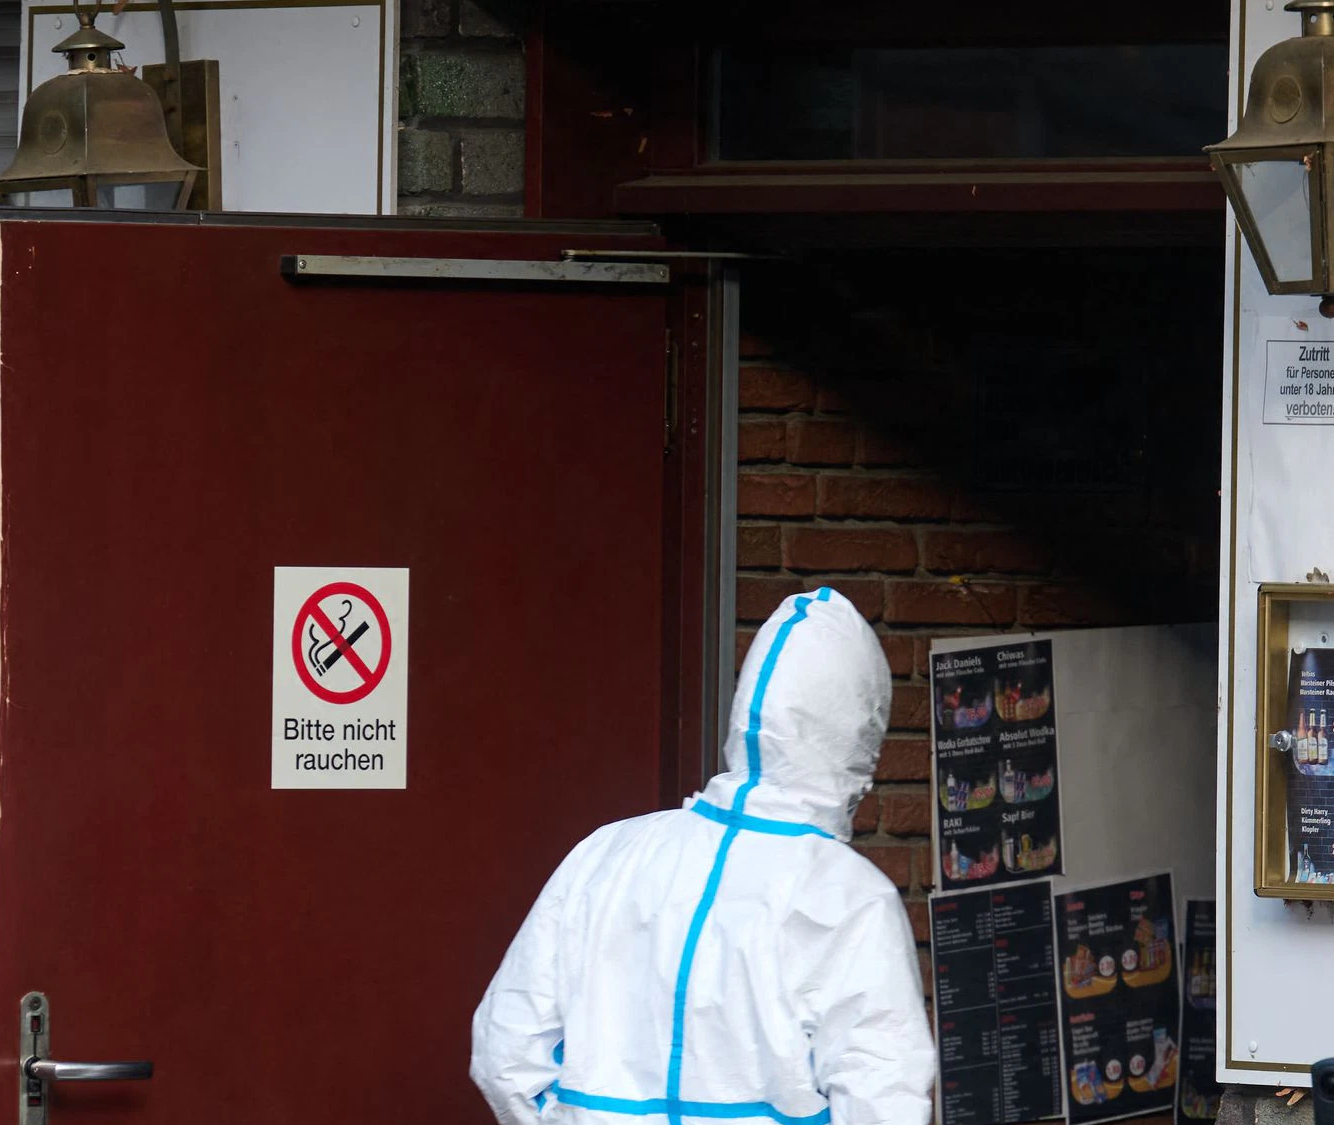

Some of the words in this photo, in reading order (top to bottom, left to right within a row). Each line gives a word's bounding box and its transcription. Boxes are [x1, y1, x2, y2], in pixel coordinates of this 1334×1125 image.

[1299, 346, 1330, 361] Zutritt
[1286, 366, 1299, 379] für
[1280, 384, 1302, 395] unter
[1304, 383, 1314, 395] 18
[284, 718, 335, 741] Bitte
[343, 718, 396, 741] nicht
[296, 748, 384, 770] rauchen
